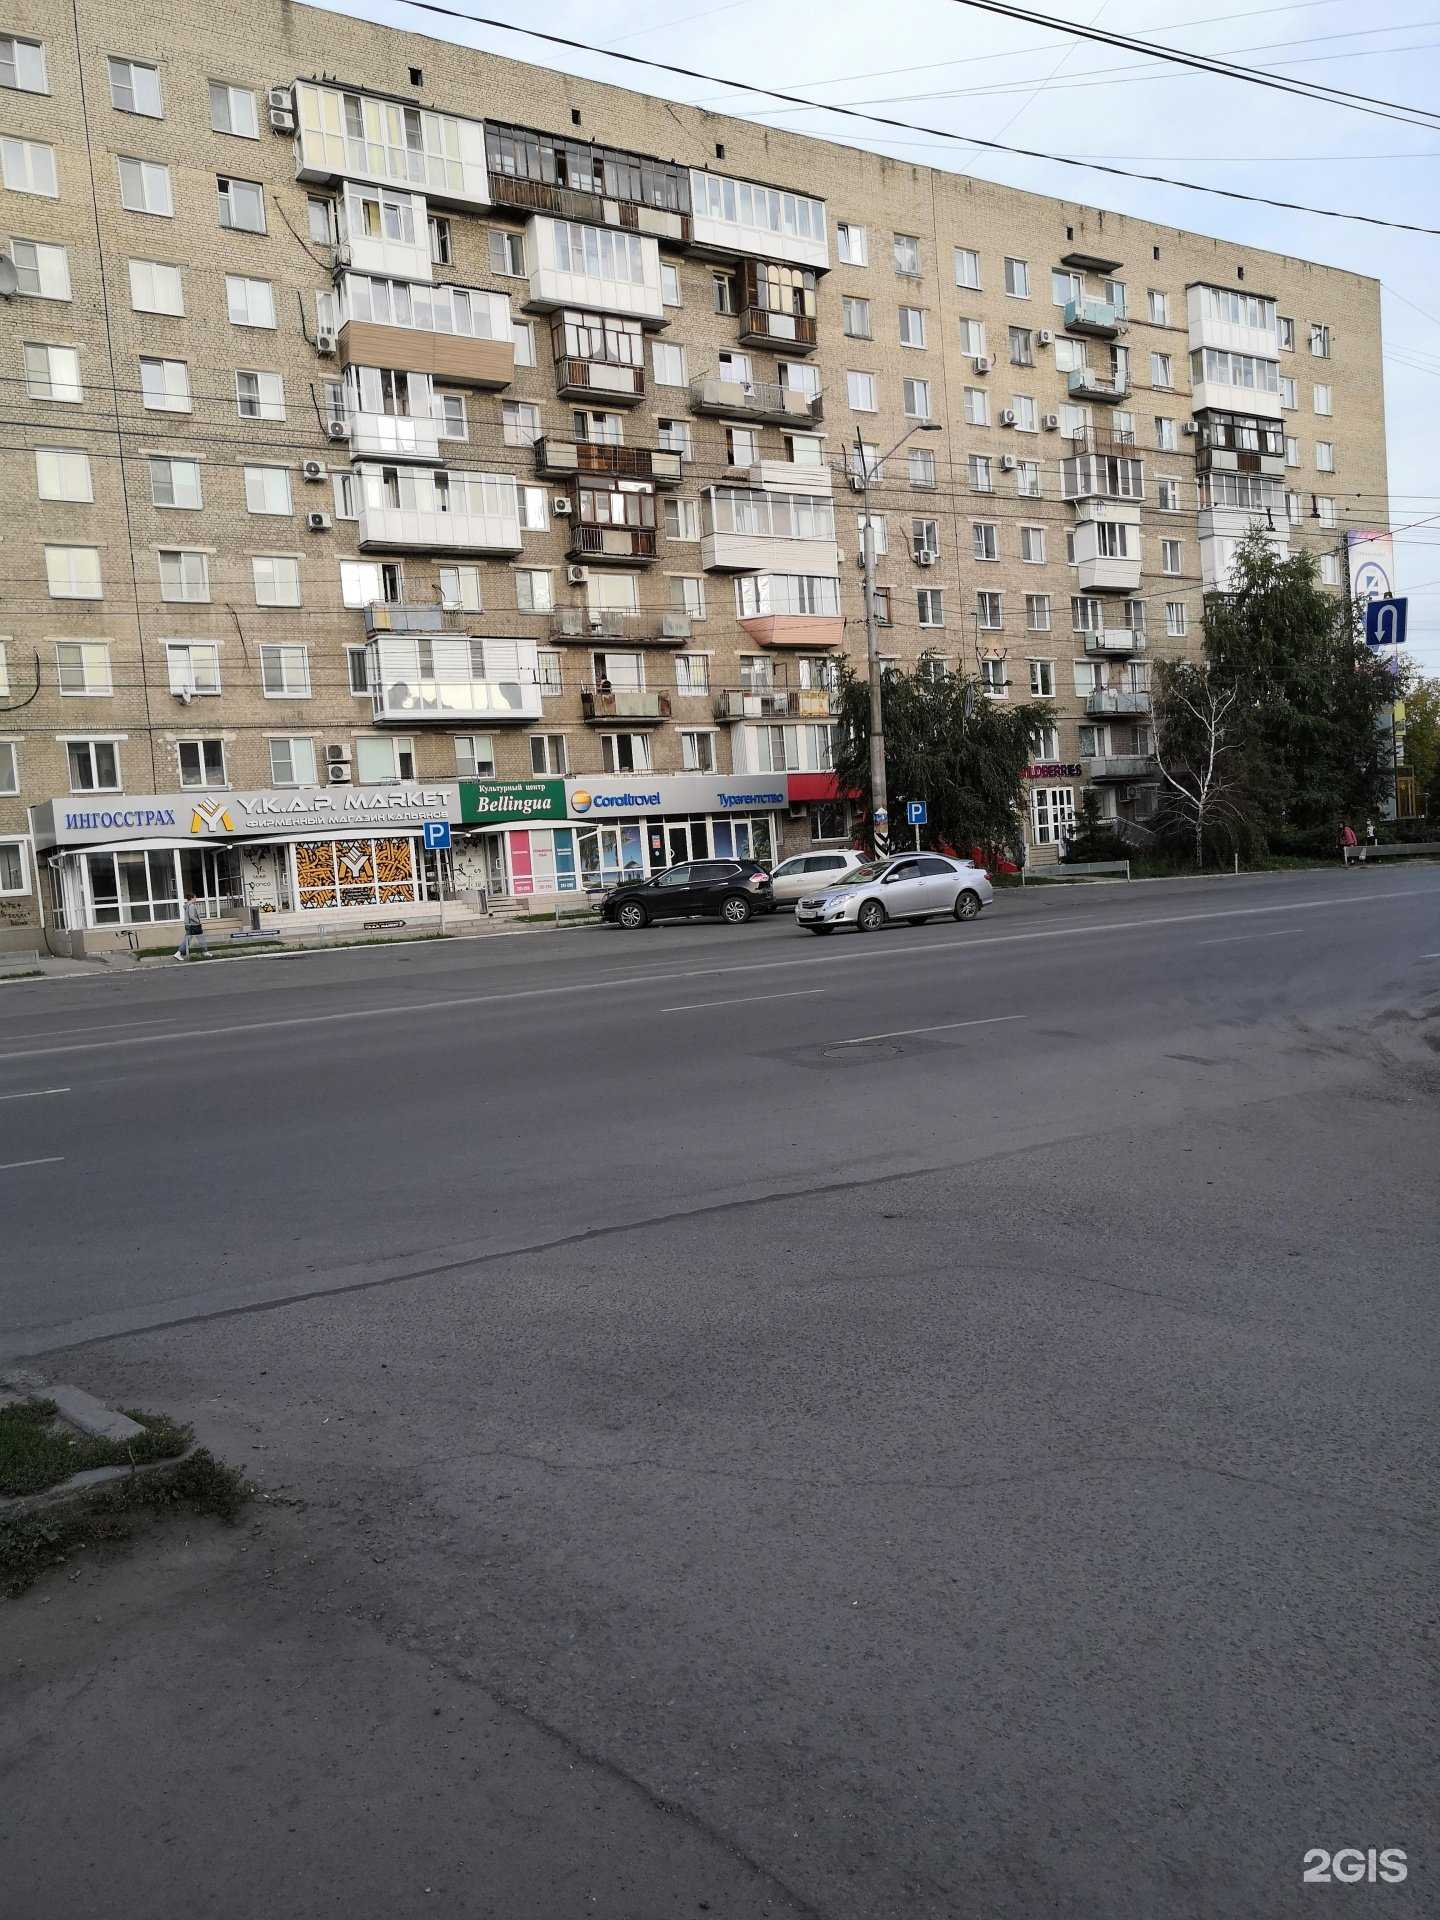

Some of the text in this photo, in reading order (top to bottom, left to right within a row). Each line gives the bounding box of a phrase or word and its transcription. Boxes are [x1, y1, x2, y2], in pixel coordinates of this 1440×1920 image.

[479, 784, 546, 793] Культурный центр
[344, 791, 453, 811] MARKET
[477, 796, 551, 815] Bellingua
[717, 793, 784, 807] Турагентство
[65, 809, 176, 830] ИНГОССТРАХ
[245, 810, 449, 828] ФИРМЕННЫЙ МАГАЗИН КАЛЬЯНОВ
[911, 803, 923, 822] P
[429, 824, 444, 846] P
